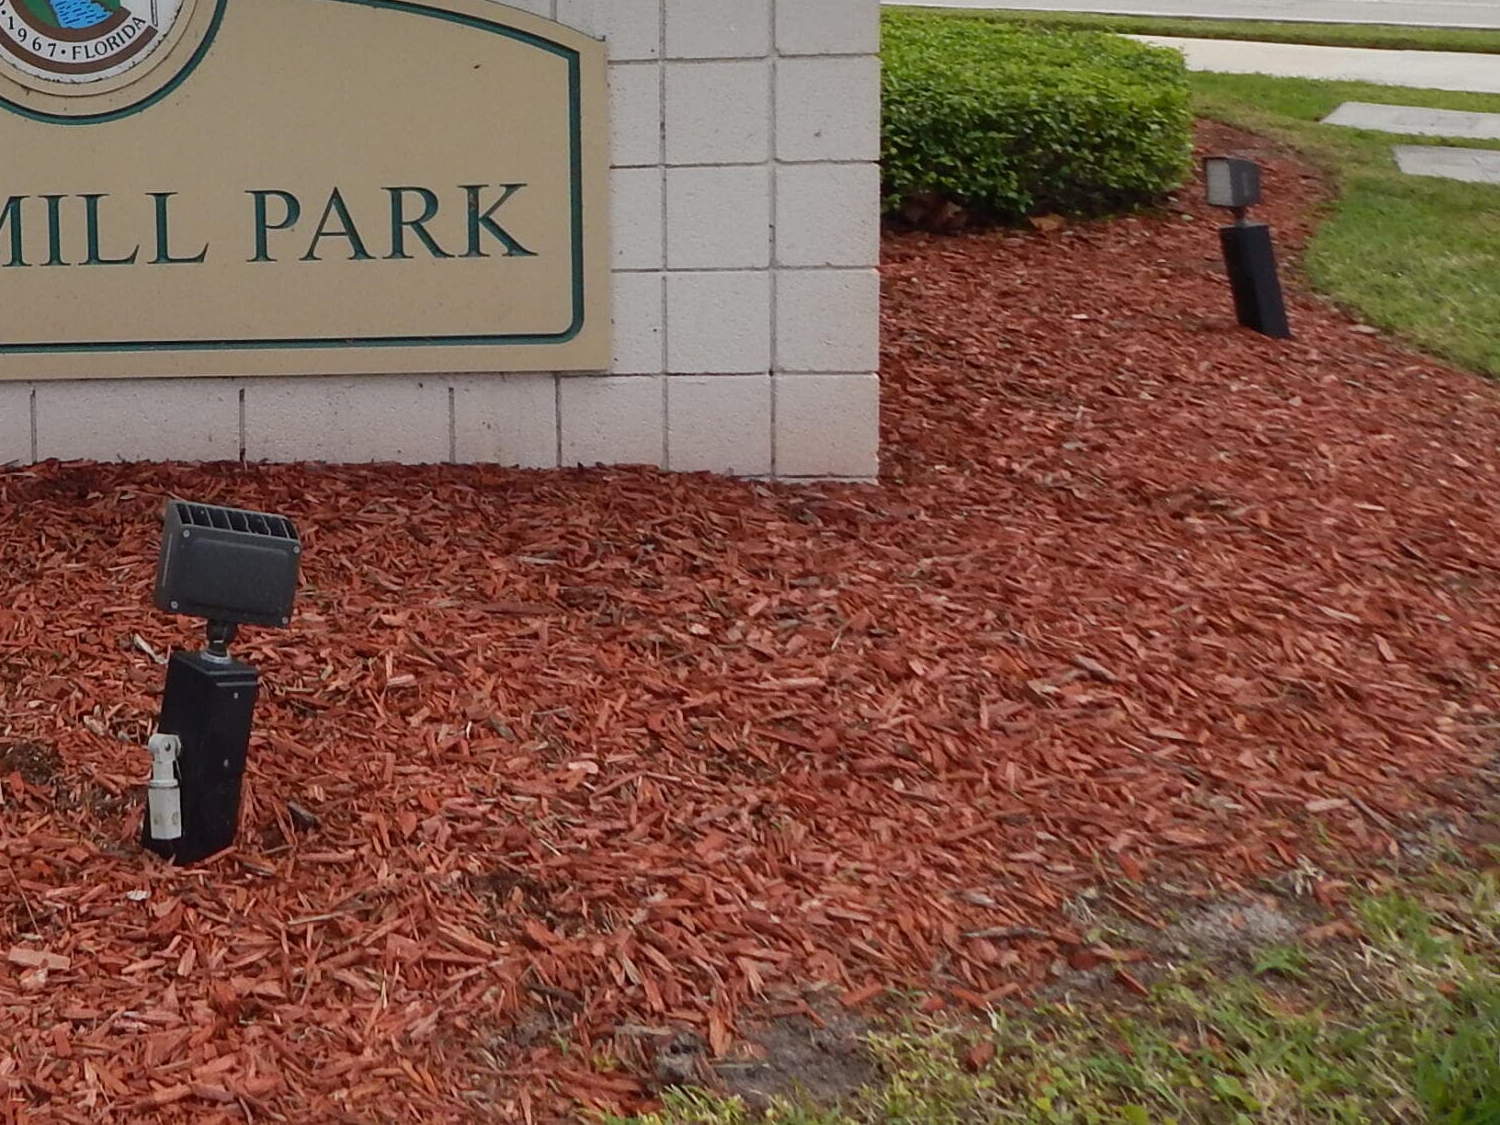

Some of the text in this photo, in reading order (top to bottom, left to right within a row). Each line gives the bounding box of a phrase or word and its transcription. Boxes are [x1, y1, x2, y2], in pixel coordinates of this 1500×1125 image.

[8, 16, 57, 57] 1967
[71, 16, 146, 60] FLORIDA
[244, 183, 539, 263] PARK
